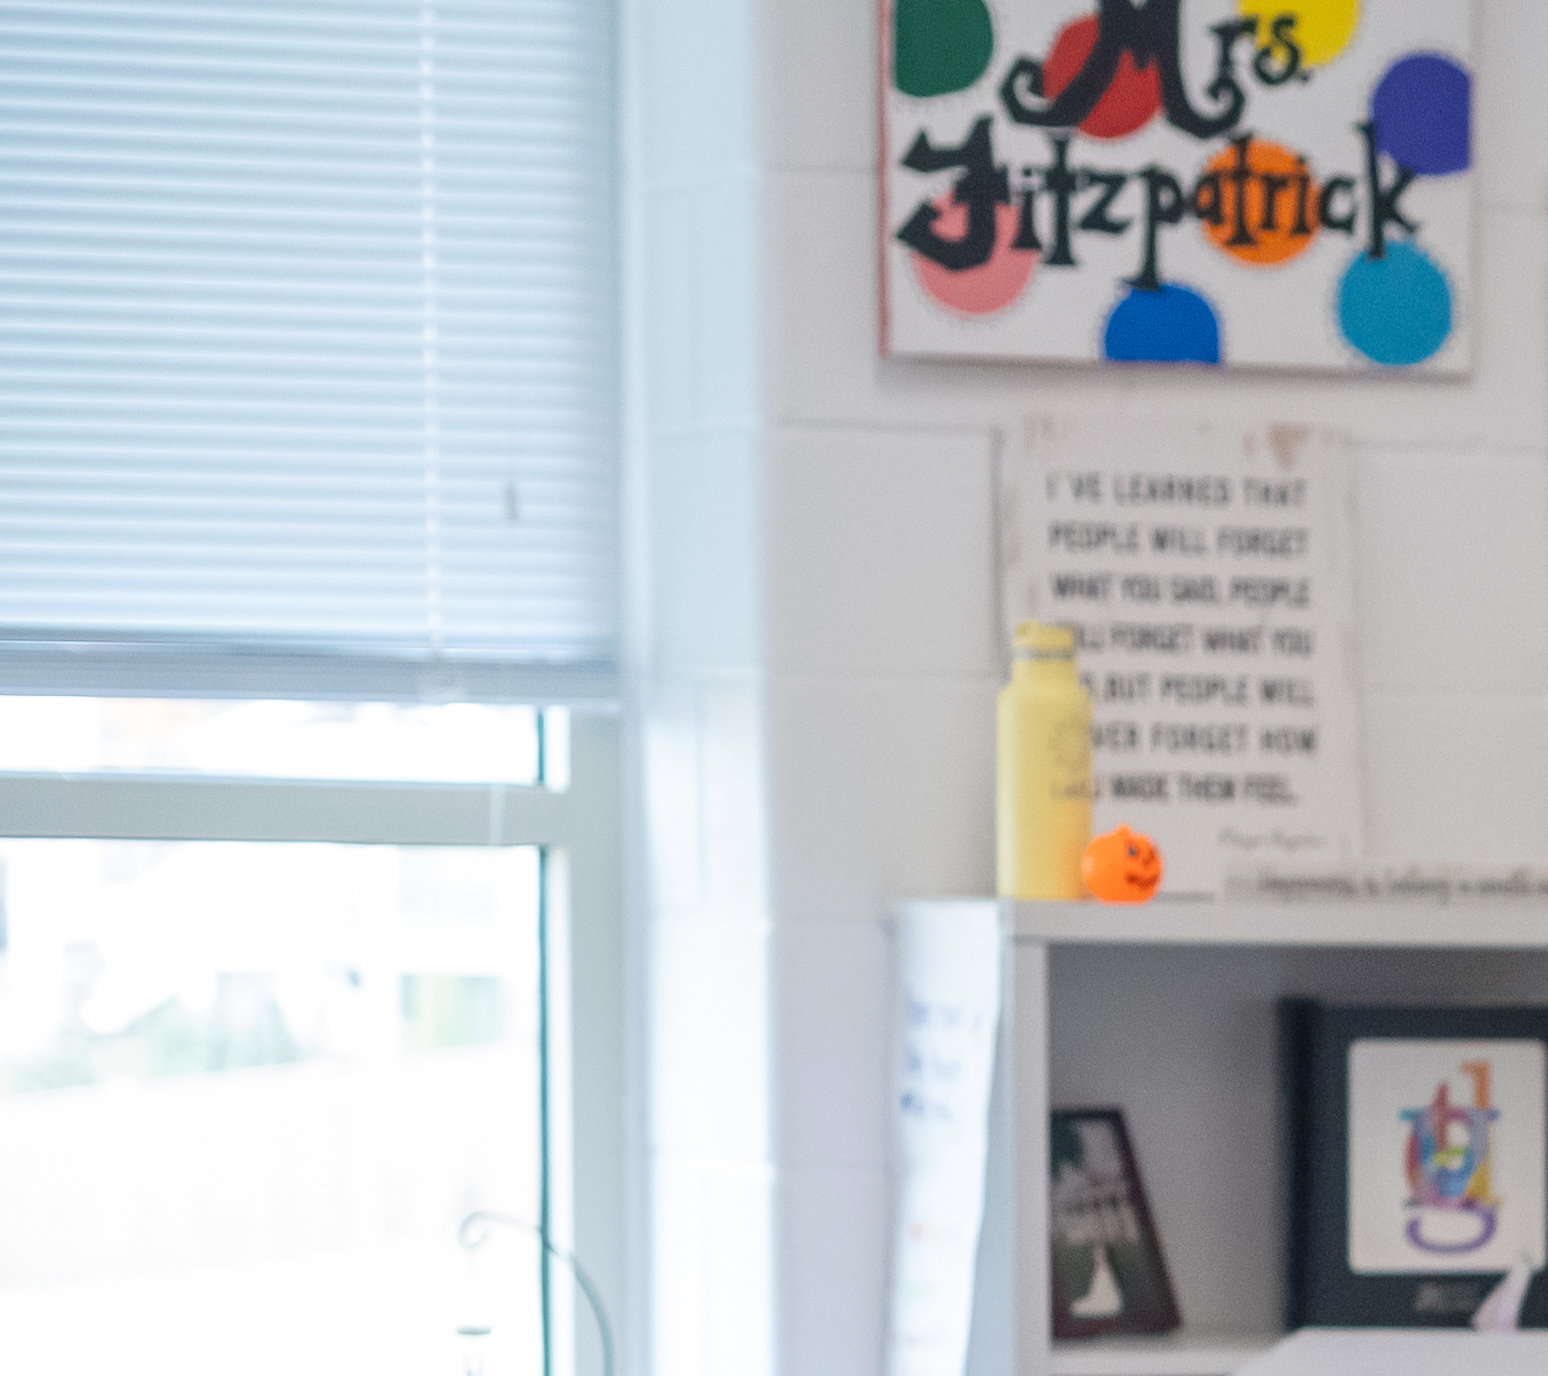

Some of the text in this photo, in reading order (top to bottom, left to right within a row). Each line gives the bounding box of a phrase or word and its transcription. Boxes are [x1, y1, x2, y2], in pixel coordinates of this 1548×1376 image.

[1000, 0, 1309, 140] Mrs.
[896, 112, 1419, 292] Fitzpatrick
[1112, 472, 1308, 509] LEARNED THAT
[1049, 519, 1311, 560] PEOPLE WILL FORGET
[1051, 572, 1112, 600] WHAT
[1110, 621, 1196, 655] FORGET
[1204, 623, 1264, 656] WHAT
[1160, 673, 1248, 709] PEOPLE
[1150, 721, 1318, 757] FORGET HOW
